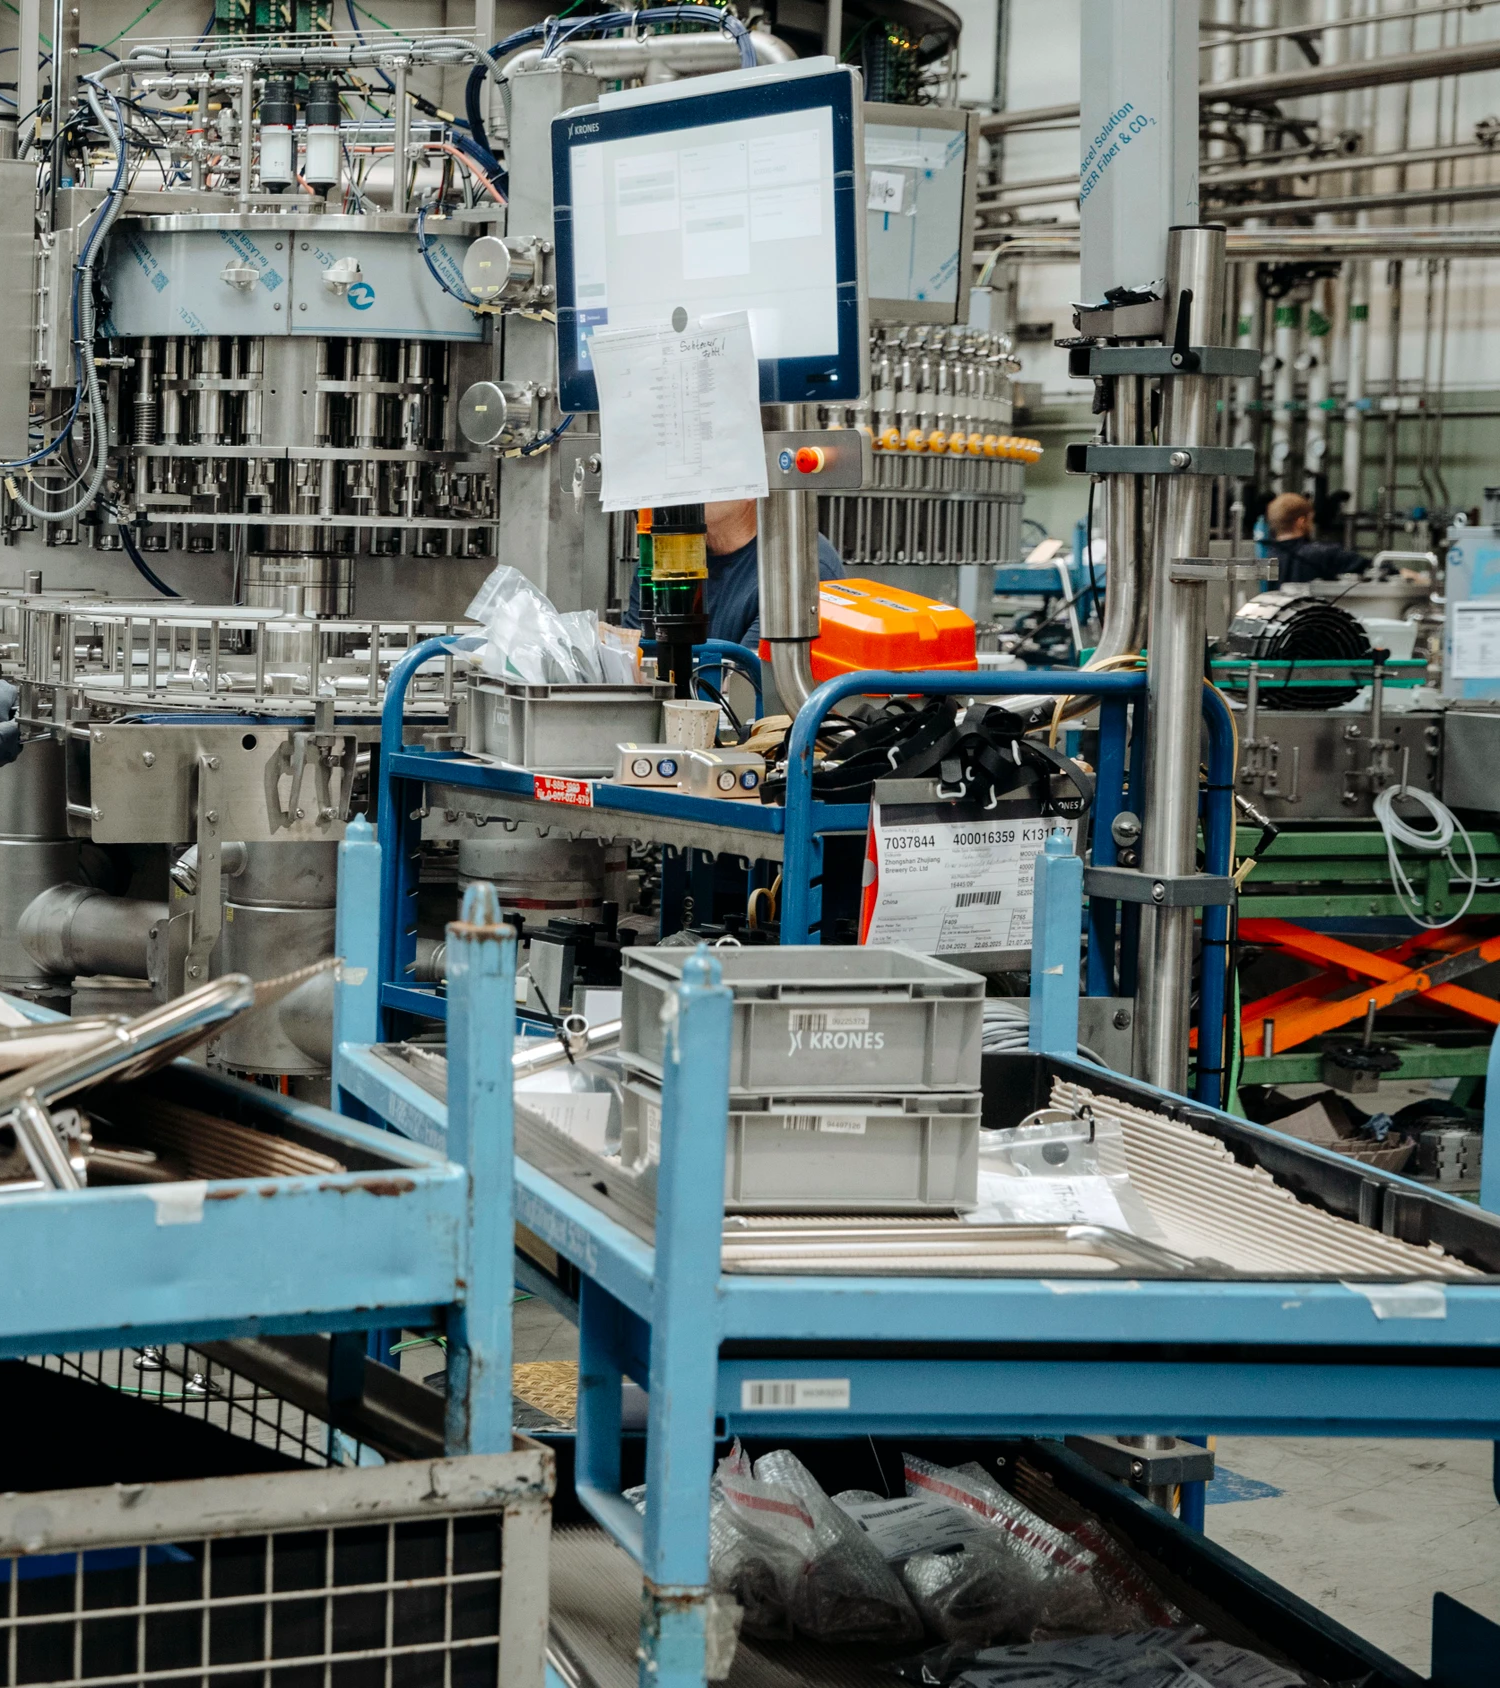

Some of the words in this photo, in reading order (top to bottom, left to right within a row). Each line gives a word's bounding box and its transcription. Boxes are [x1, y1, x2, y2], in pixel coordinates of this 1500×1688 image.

[574, 123, 600, 135] KRONES
[1094, 102, 1134, 148] Solution
[1079, 170, 1100, 207] ASER
[1096, 142, 1121, 173] Fiber
[1118, 132, 1132, 144] &
[240, 235, 260, 257] LASER
[438, 243, 449, 258] The
[258, 256, 268, 267] for
[437, 261, 456, 288] LASER
[884, 835, 935, 850] 7037844
[953, 830, 1015, 846] 400016359
[885, 858, 916, 866] Zhongshan
[917, 856, 941, 864] Zhujiang
[810, 1031, 885, 1050] KRONES
